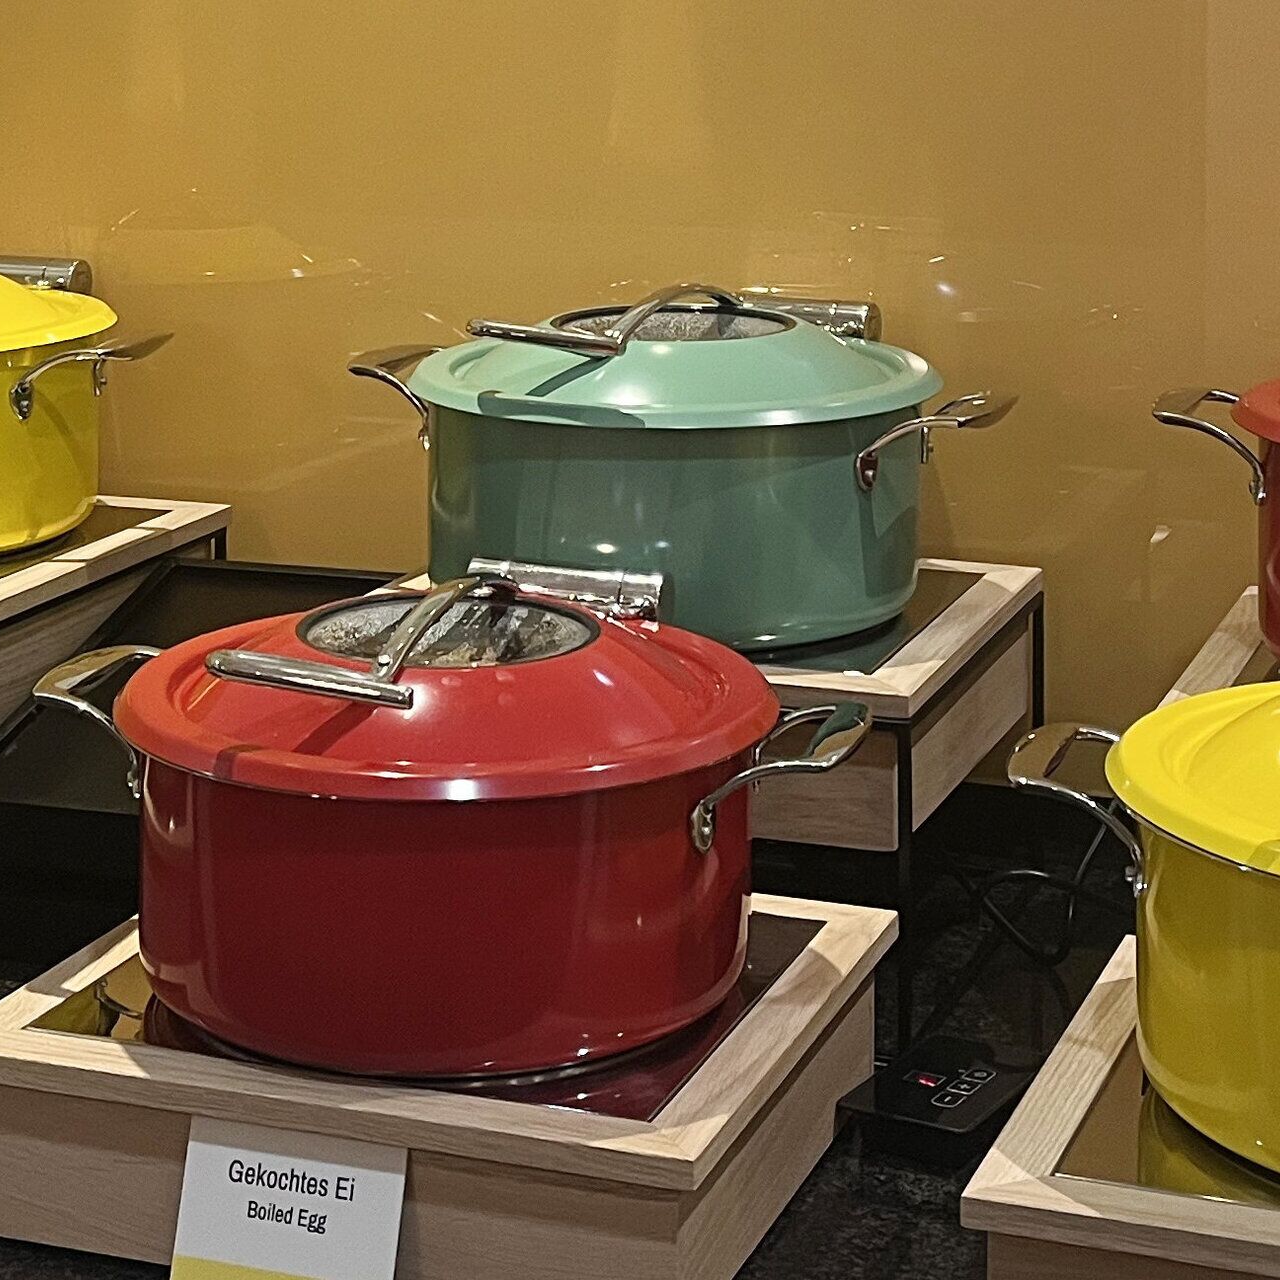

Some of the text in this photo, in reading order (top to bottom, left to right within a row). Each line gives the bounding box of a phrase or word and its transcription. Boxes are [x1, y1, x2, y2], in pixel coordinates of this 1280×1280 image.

[228, 1158, 356, 1202] Gekochtes Ei
[247, 1200, 328, 1235] Boiled Egg
